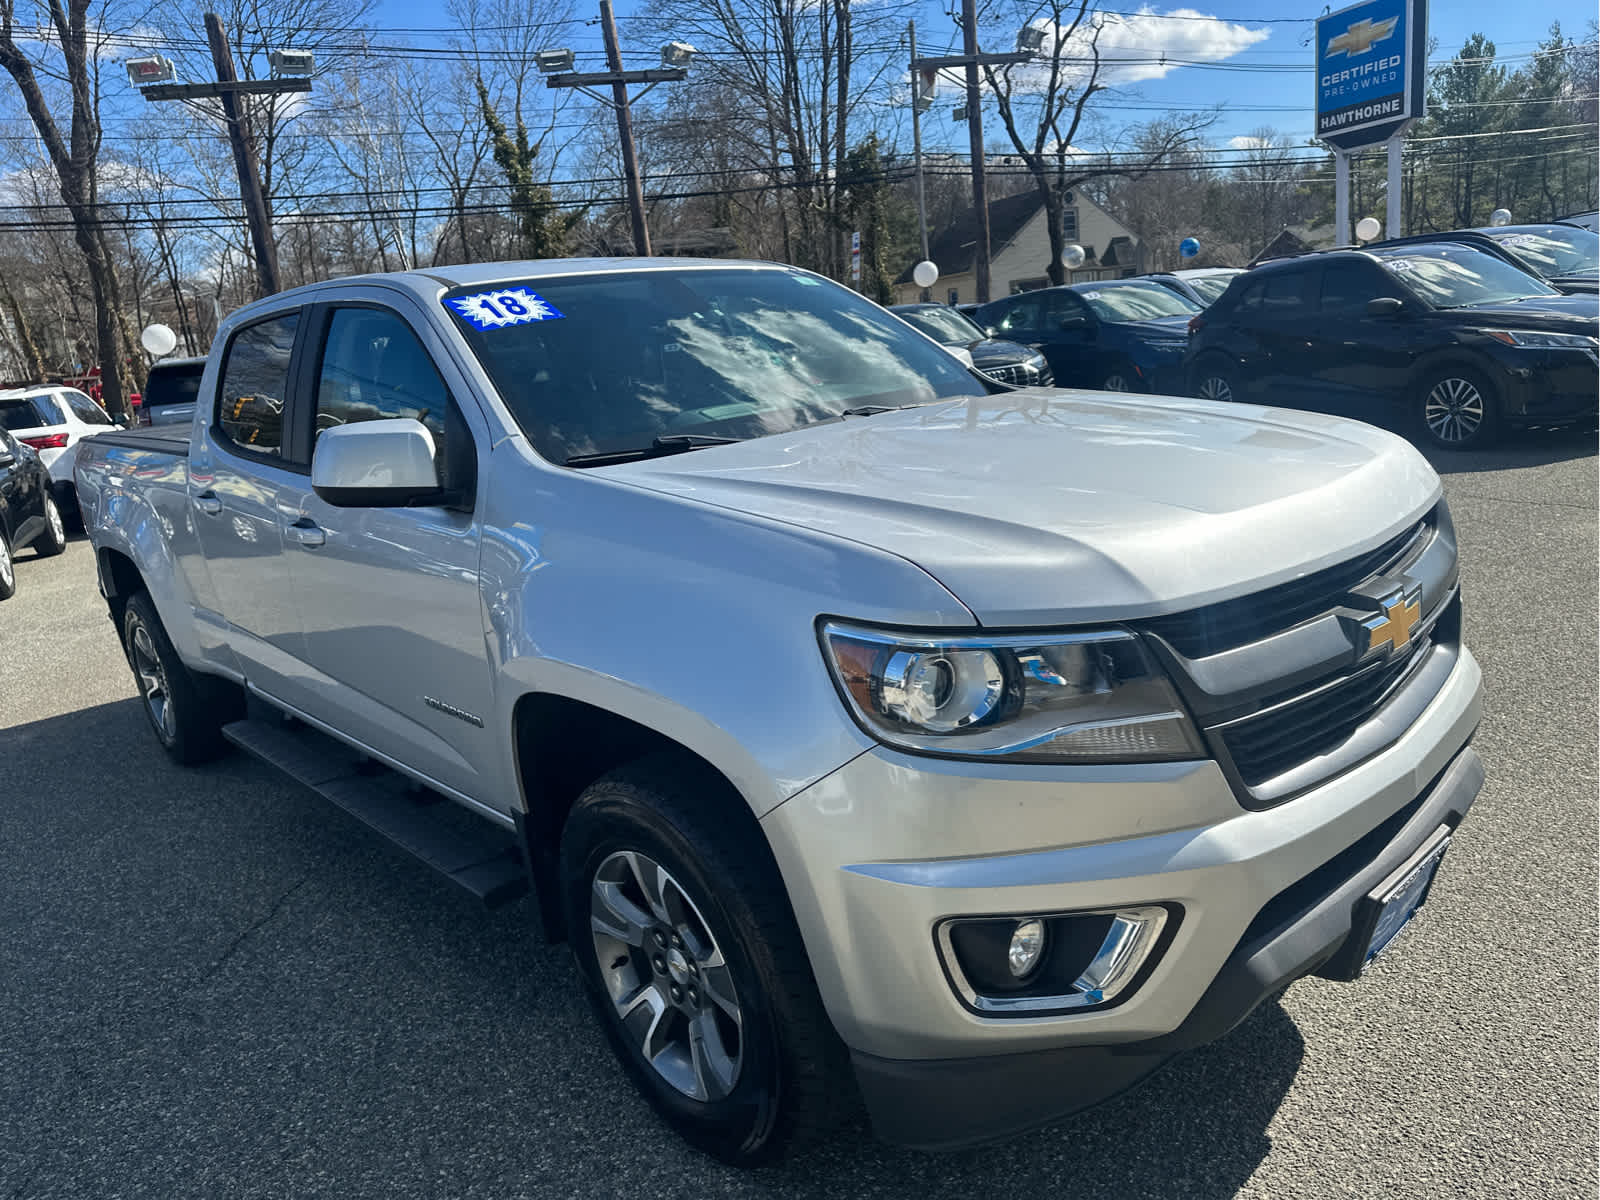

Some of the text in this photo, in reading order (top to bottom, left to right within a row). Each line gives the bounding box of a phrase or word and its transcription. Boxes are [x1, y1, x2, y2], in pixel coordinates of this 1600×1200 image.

[1321, 55, 1400, 87] CERTIFIED
[1324, 71, 1397, 98] PRE-OWNED
[1321, 99, 1400, 129] HAWTHORNE
[479, 295, 528, 319] 18
